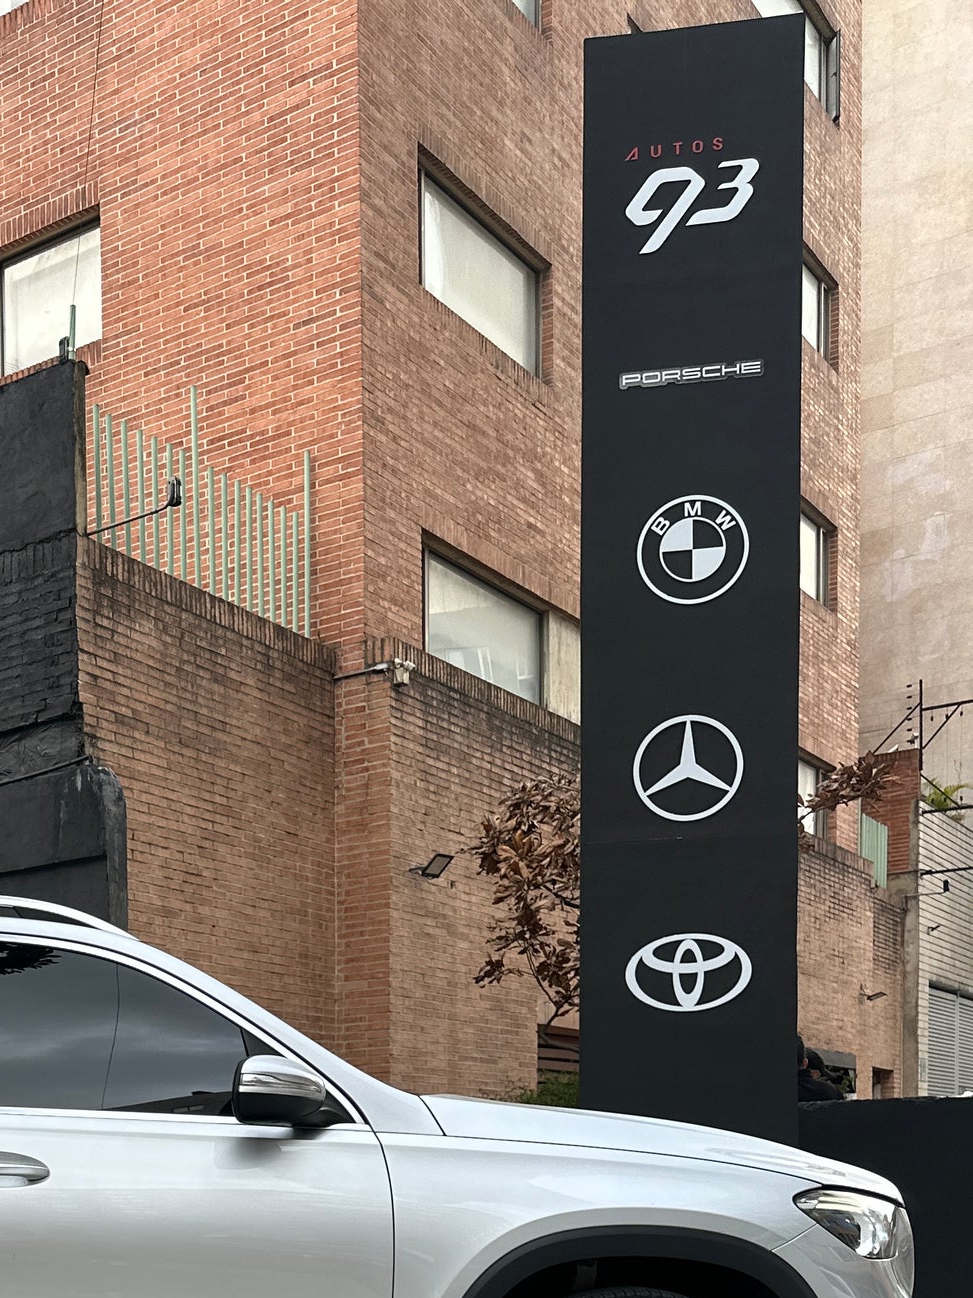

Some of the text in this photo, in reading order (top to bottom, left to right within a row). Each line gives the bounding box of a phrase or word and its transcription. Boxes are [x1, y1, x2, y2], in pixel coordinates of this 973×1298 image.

[625, 137, 724, 161] AUTOS
[625, 158, 760, 255] 93
[621, 360, 762, 387] PORSCHE
[650, 501, 737, 536] BMW
